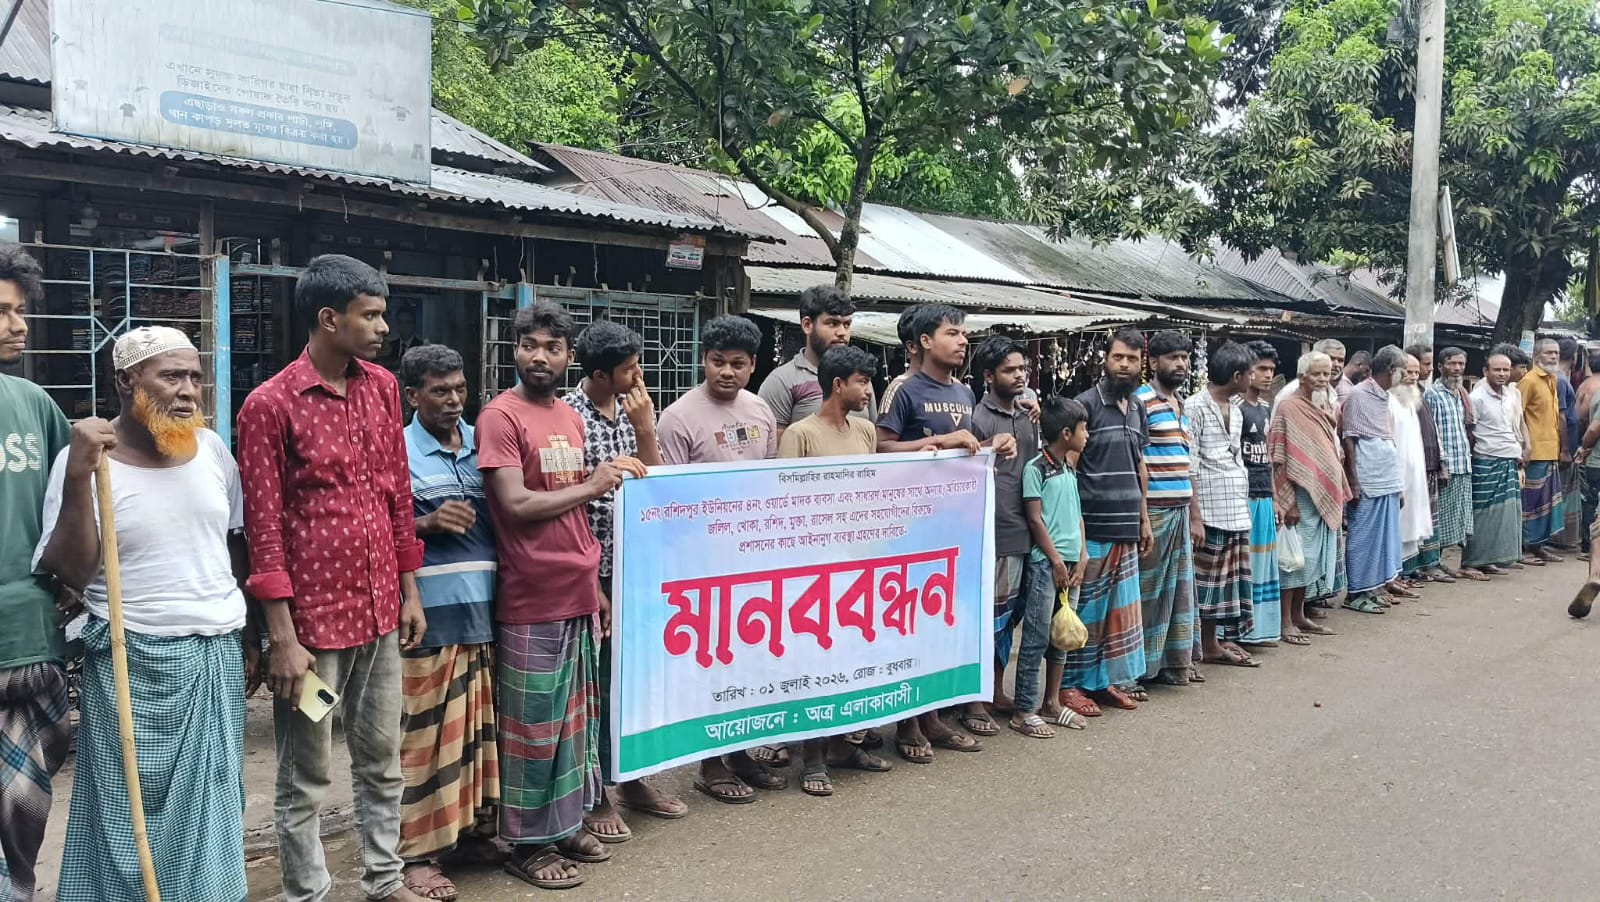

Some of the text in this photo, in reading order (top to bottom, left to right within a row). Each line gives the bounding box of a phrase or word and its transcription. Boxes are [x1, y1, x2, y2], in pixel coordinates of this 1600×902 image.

[165, 61, 200, 74] এখানে
[177, 73, 232, 94] ডিজাইনের
[191, 112, 222, 127] কাপড়
[778, 466, 876, 485] বিসমিল্লাহির রাহমানির রাহিম
[640, 506, 663, 522] ১৫নং
[664, 501, 699, 521] রশিদপুর
[700, 498, 743, 516] ইউনিয়নের
[745, 499, 763, 514] ৪নং
[765, 493, 789, 511] ওয়ার্ডে
[791, 494, 812, 509] মাদক
[814, 492, 836, 506] ব্যবসা
[837, 491, 853, 505] এবং
[855, 490, 880, 502] সাধারণ
[882, 487, 905, 502] মানুষের
[907, 486, 923, 498] সাথে
[707, 502, 933, 537] জলিল, খোকা, রশিদ, মুক্তা, রাসেল সহ এদের সহযোগীদের বিরুদ্ধে
[738, 538, 775, 554] প্রশাসনের
[777, 536, 797, 549] কাছে
[798, 531, 832, 547] আইনানুগ
[833, 530, 855, 545] ব্যবস্থা
[856, 528, 881, 541] গ্রহণের
[661, 546, 959, 669] মানববন্ধন
[712, 685, 748, 704] তারিখ
[759, 683, 775, 696] ০১
[779, 675, 811, 694] জুলাই
[814, 672, 850, 687] ২০২৬,
[853, 663, 876, 681] রোজ
[704, 709, 788, 742] আয়োজনে
[804, 703, 835, 722] অত্র
